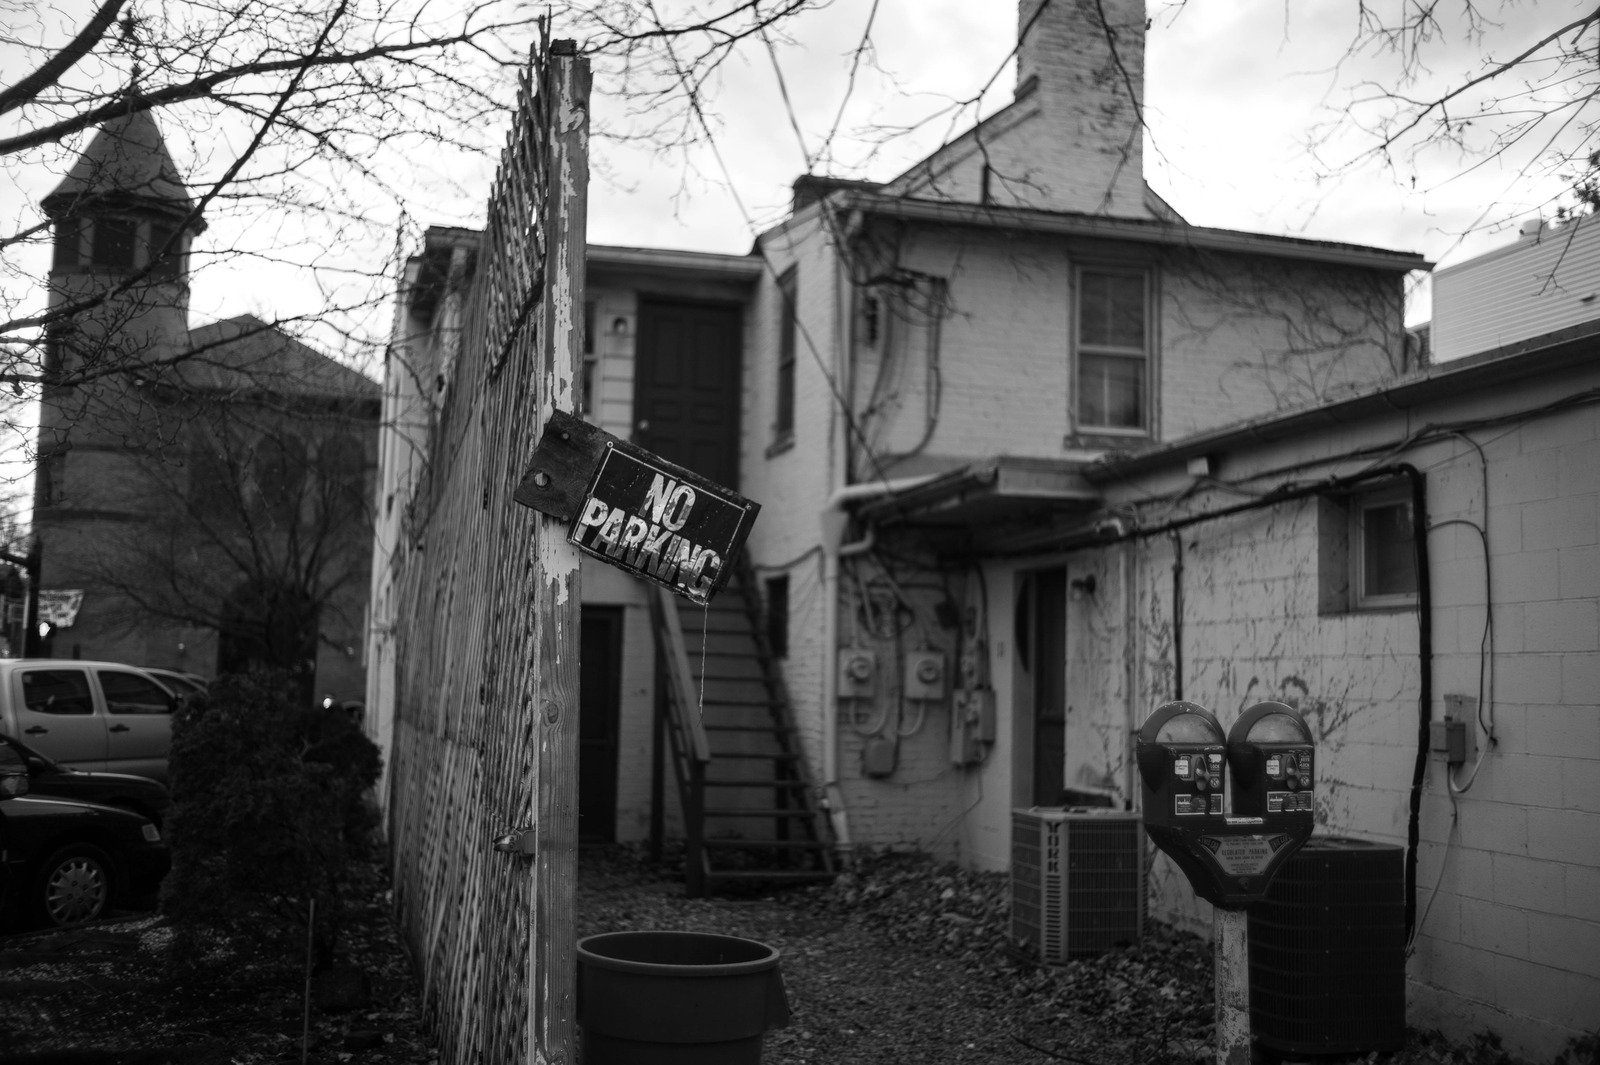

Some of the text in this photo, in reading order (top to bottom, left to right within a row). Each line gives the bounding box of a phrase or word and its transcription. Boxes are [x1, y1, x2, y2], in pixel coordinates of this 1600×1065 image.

[638, 473, 696, 532] NO
[575, 497, 721, 598] PARKING
[1046, 822, 1061, 872] YORK
